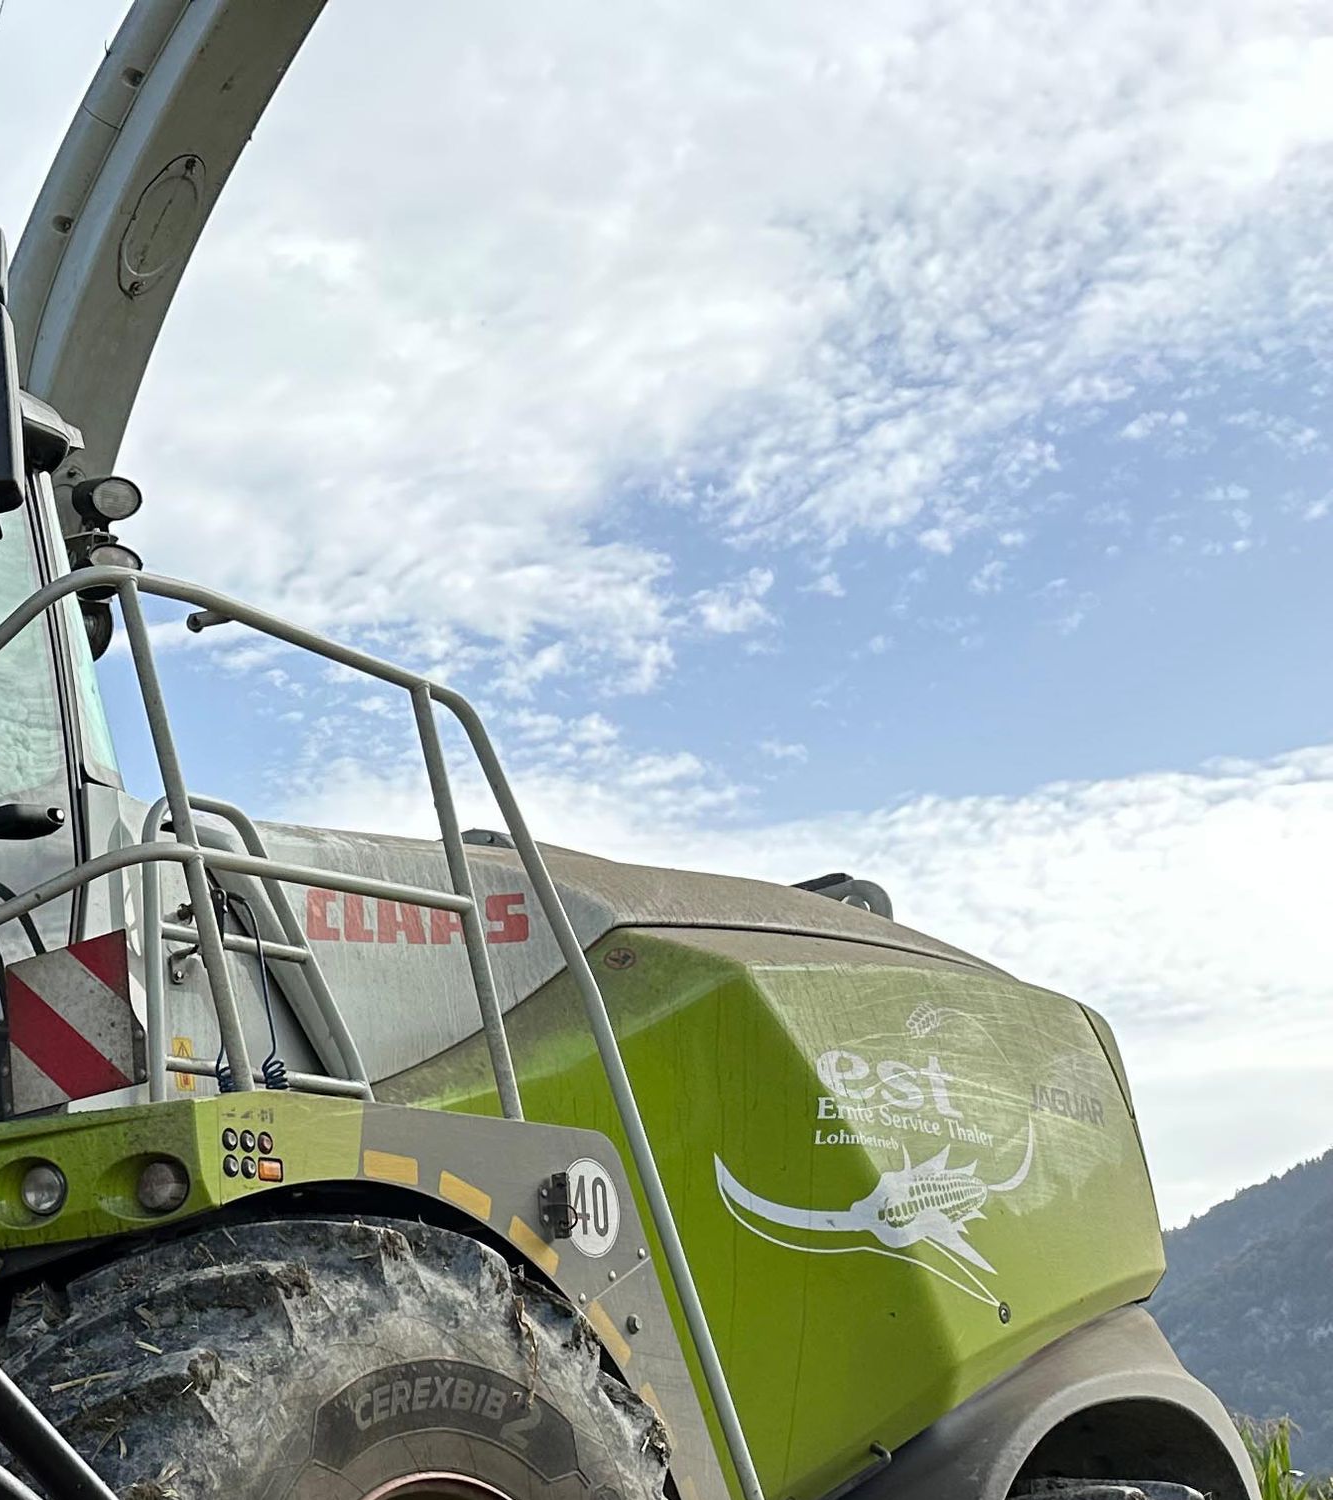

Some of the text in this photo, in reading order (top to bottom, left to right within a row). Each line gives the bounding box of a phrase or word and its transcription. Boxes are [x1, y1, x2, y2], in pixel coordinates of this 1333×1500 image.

[306, 888, 529, 945] CLAAS
[816, 1049, 965, 1122] est
[814, 1129, 900, 1151] Lohnbetrieb
[817, 1096, 995, 1149] Ernte Service Thaler
[569, 1175, 610, 1238] 40
[355, 1376, 508, 1432] CEREXBIB
